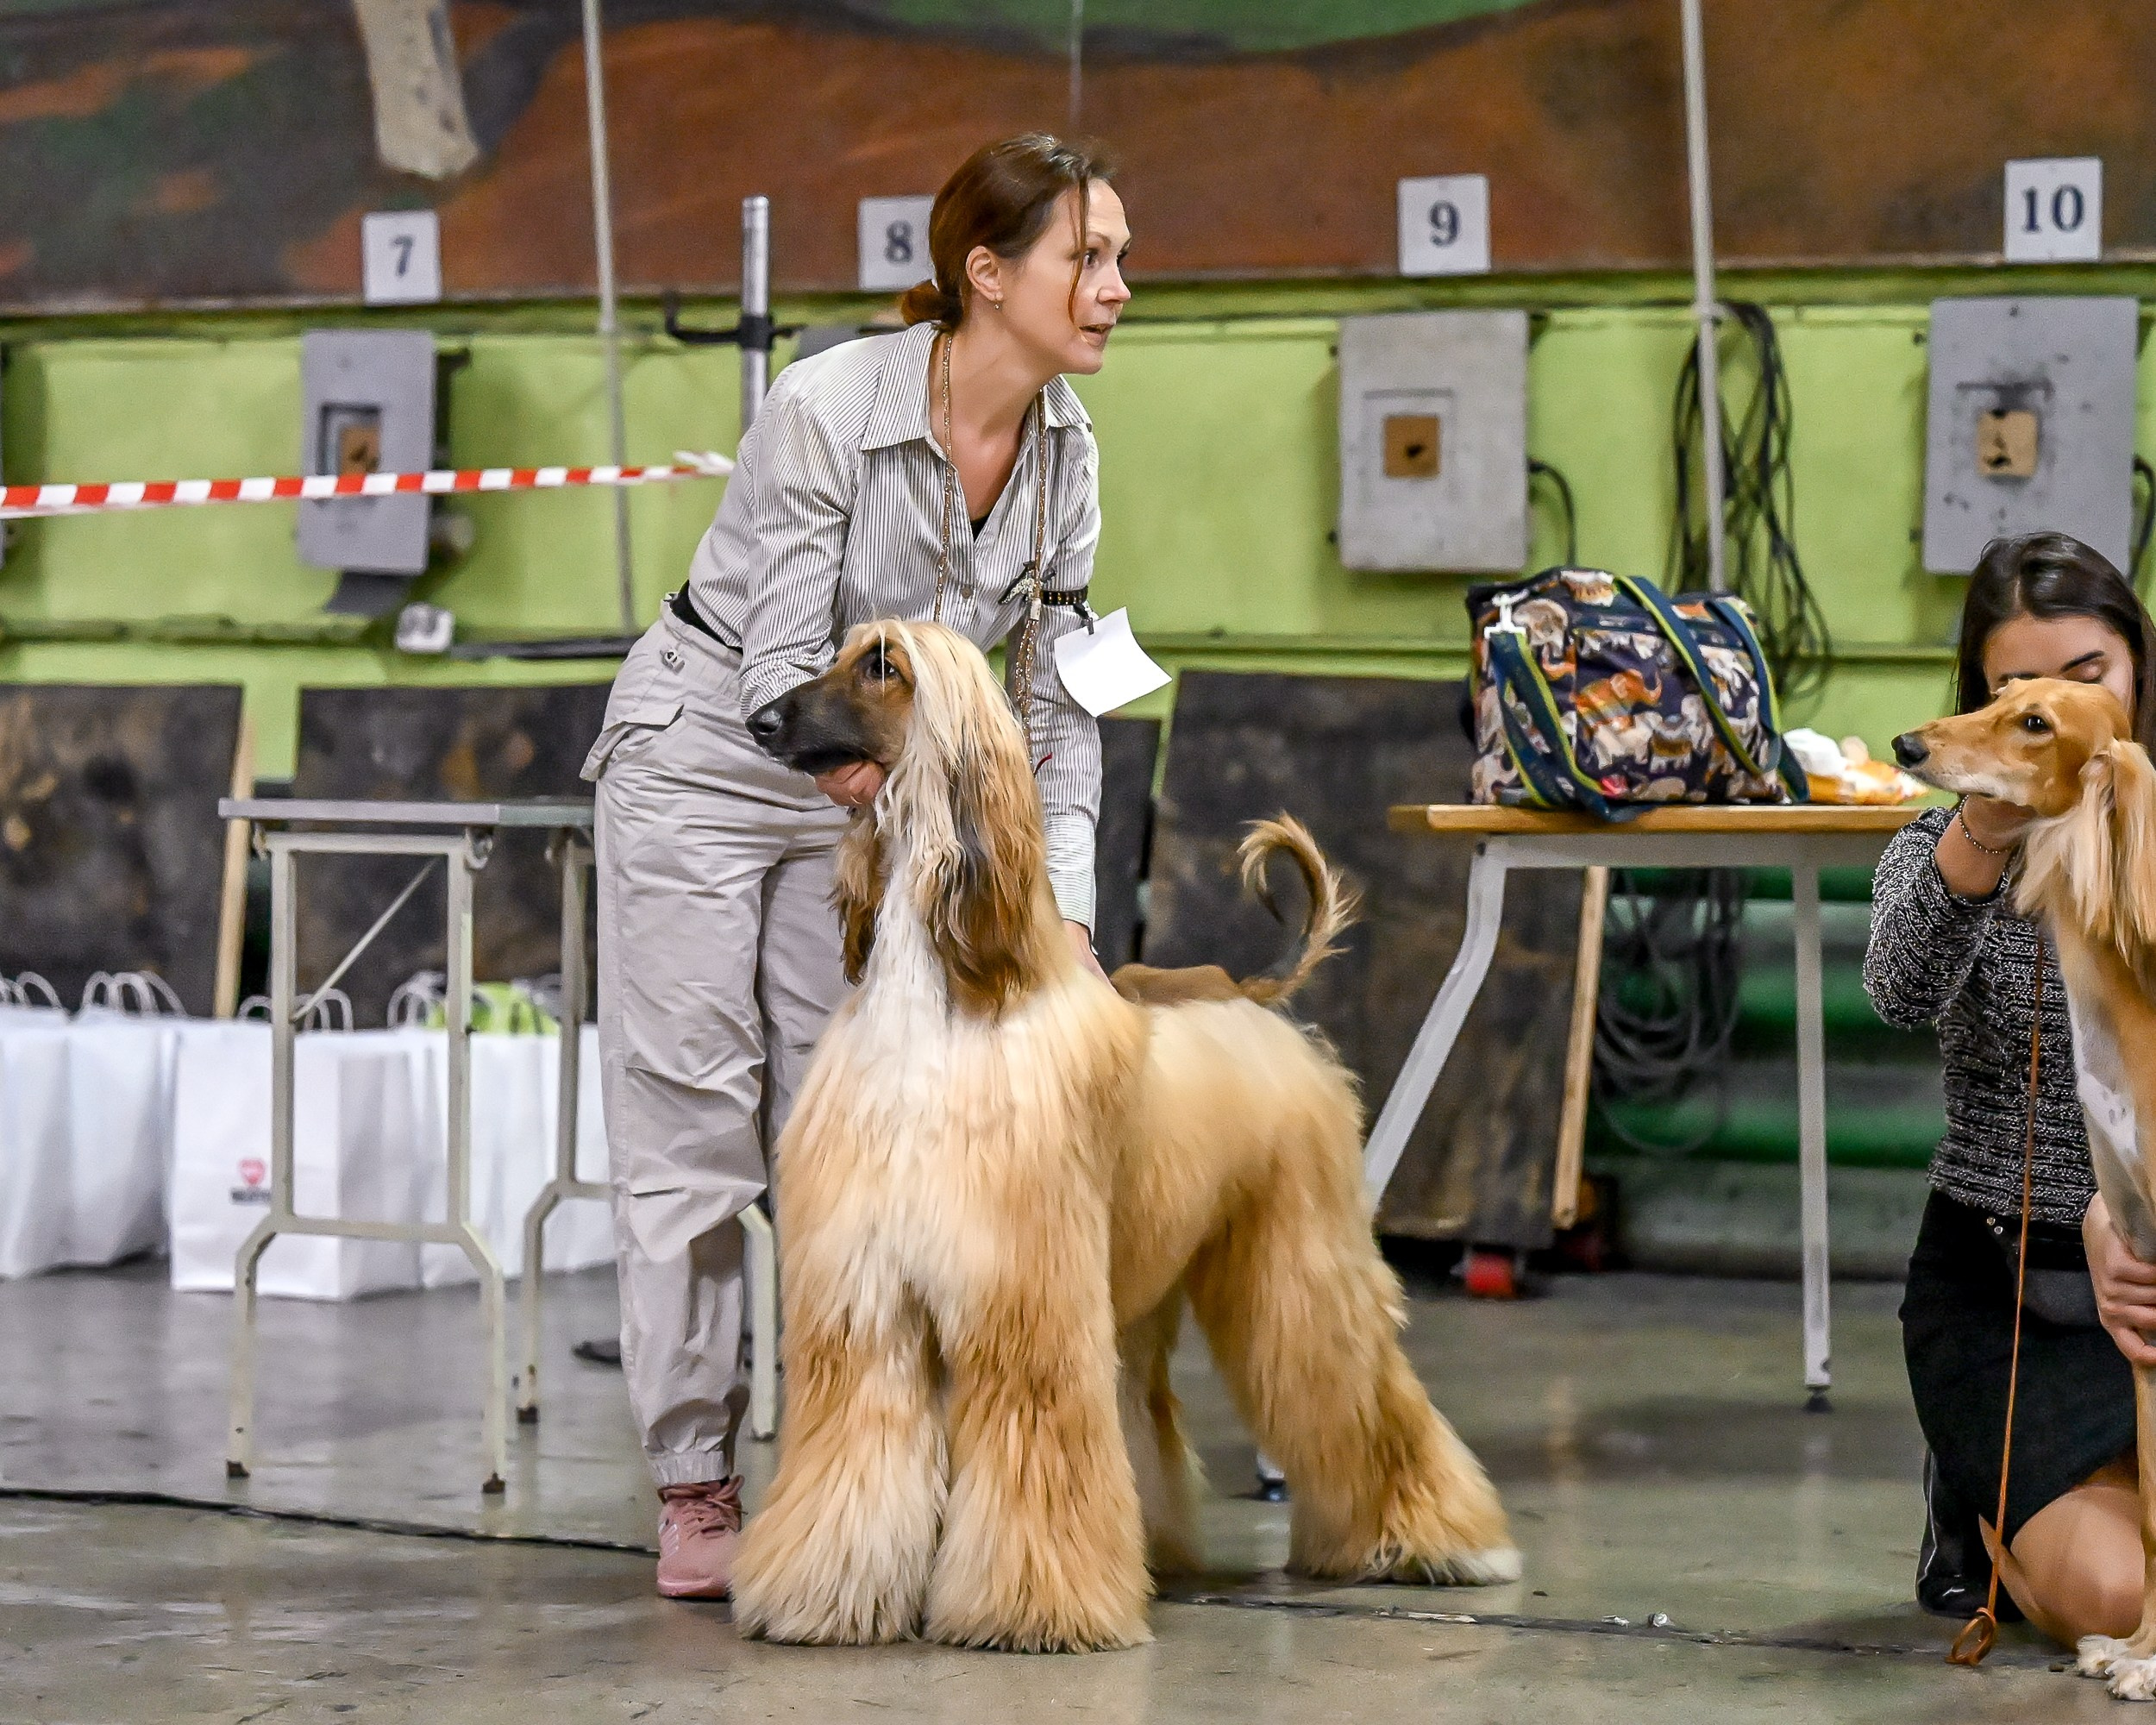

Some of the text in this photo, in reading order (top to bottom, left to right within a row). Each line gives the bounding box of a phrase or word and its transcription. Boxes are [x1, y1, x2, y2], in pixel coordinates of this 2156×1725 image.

[1429, 200, 1459, 248] 9
[2022, 185, 2084, 233] 10
[392, 235, 413, 277] 7
[884, 220, 912, 264] 8
